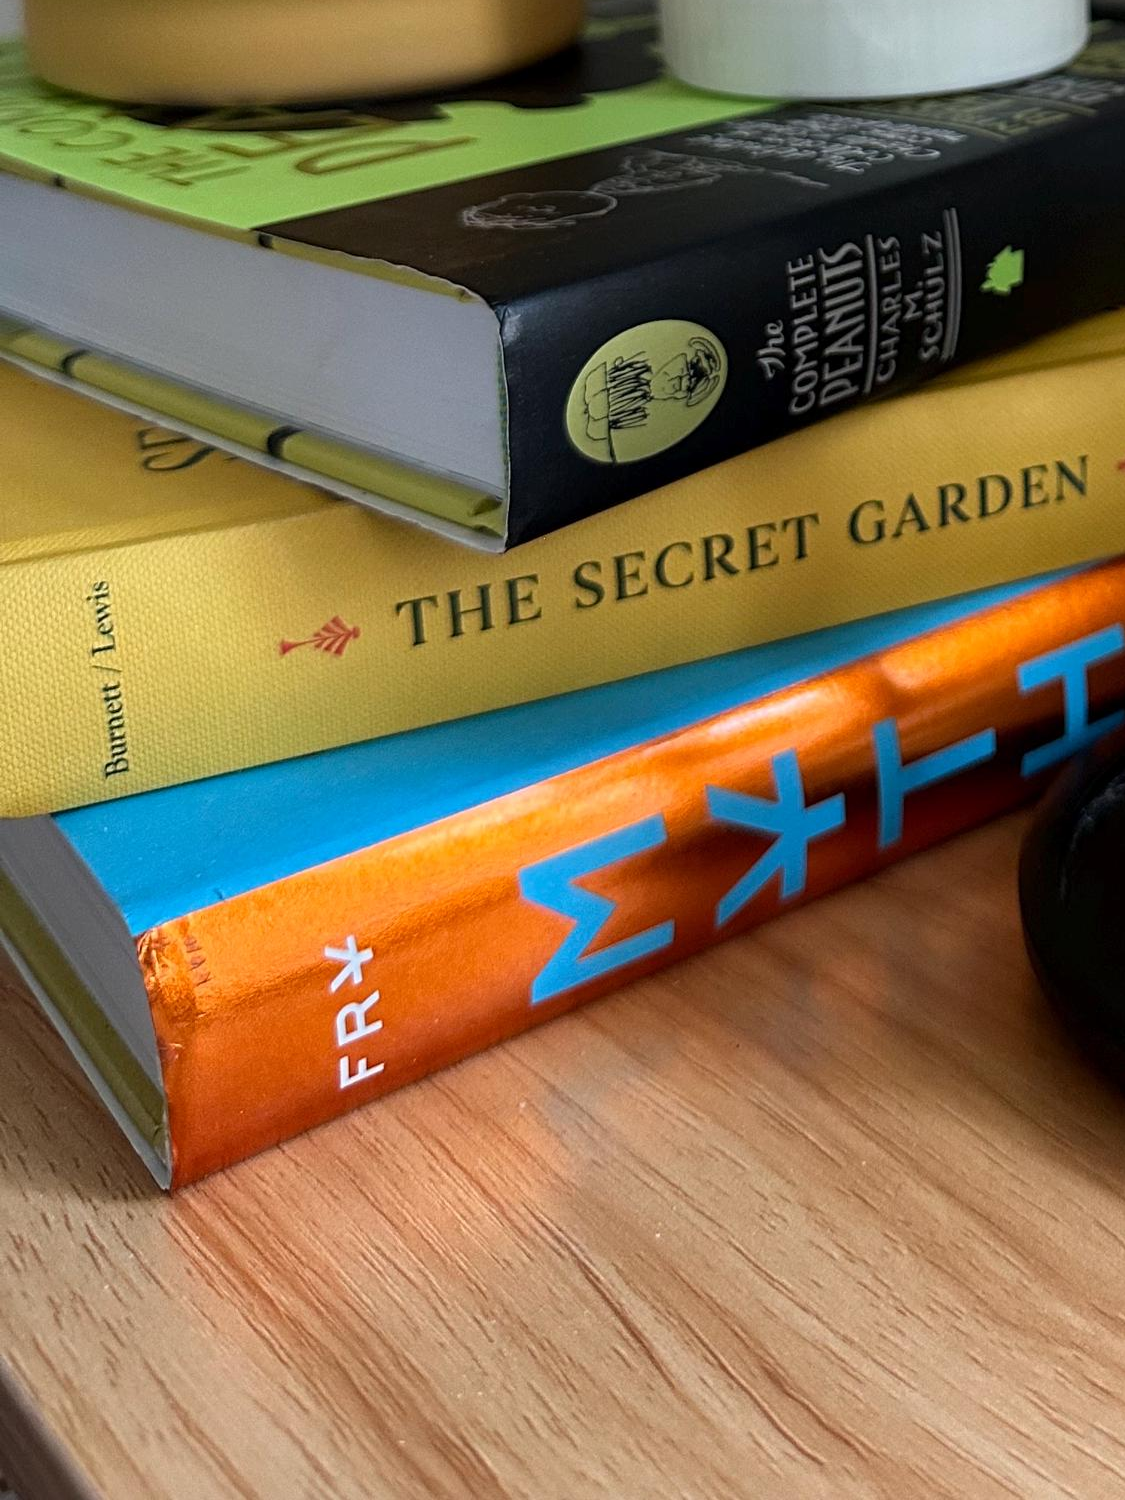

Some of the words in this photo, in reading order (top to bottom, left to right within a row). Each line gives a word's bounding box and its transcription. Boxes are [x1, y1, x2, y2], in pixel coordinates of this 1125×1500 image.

[755, 318, 786, 381] The
[786, 253, 819, 415] COMPLETE
[817, 241, 866, 407] PEANUTS
[876, 235, 903, 383] CHARLES
[902, 280, 924, 323] M.
[919, 229, 946, 362] SCHULZ
[396, 573, 543, 647] THE
[571, 512, 820, 610] SECRET
[846, 454, 1089, 546] GARDEN
[86, 579, 117, 658] Lewis
[103, 679, 129, 779] Burnett
